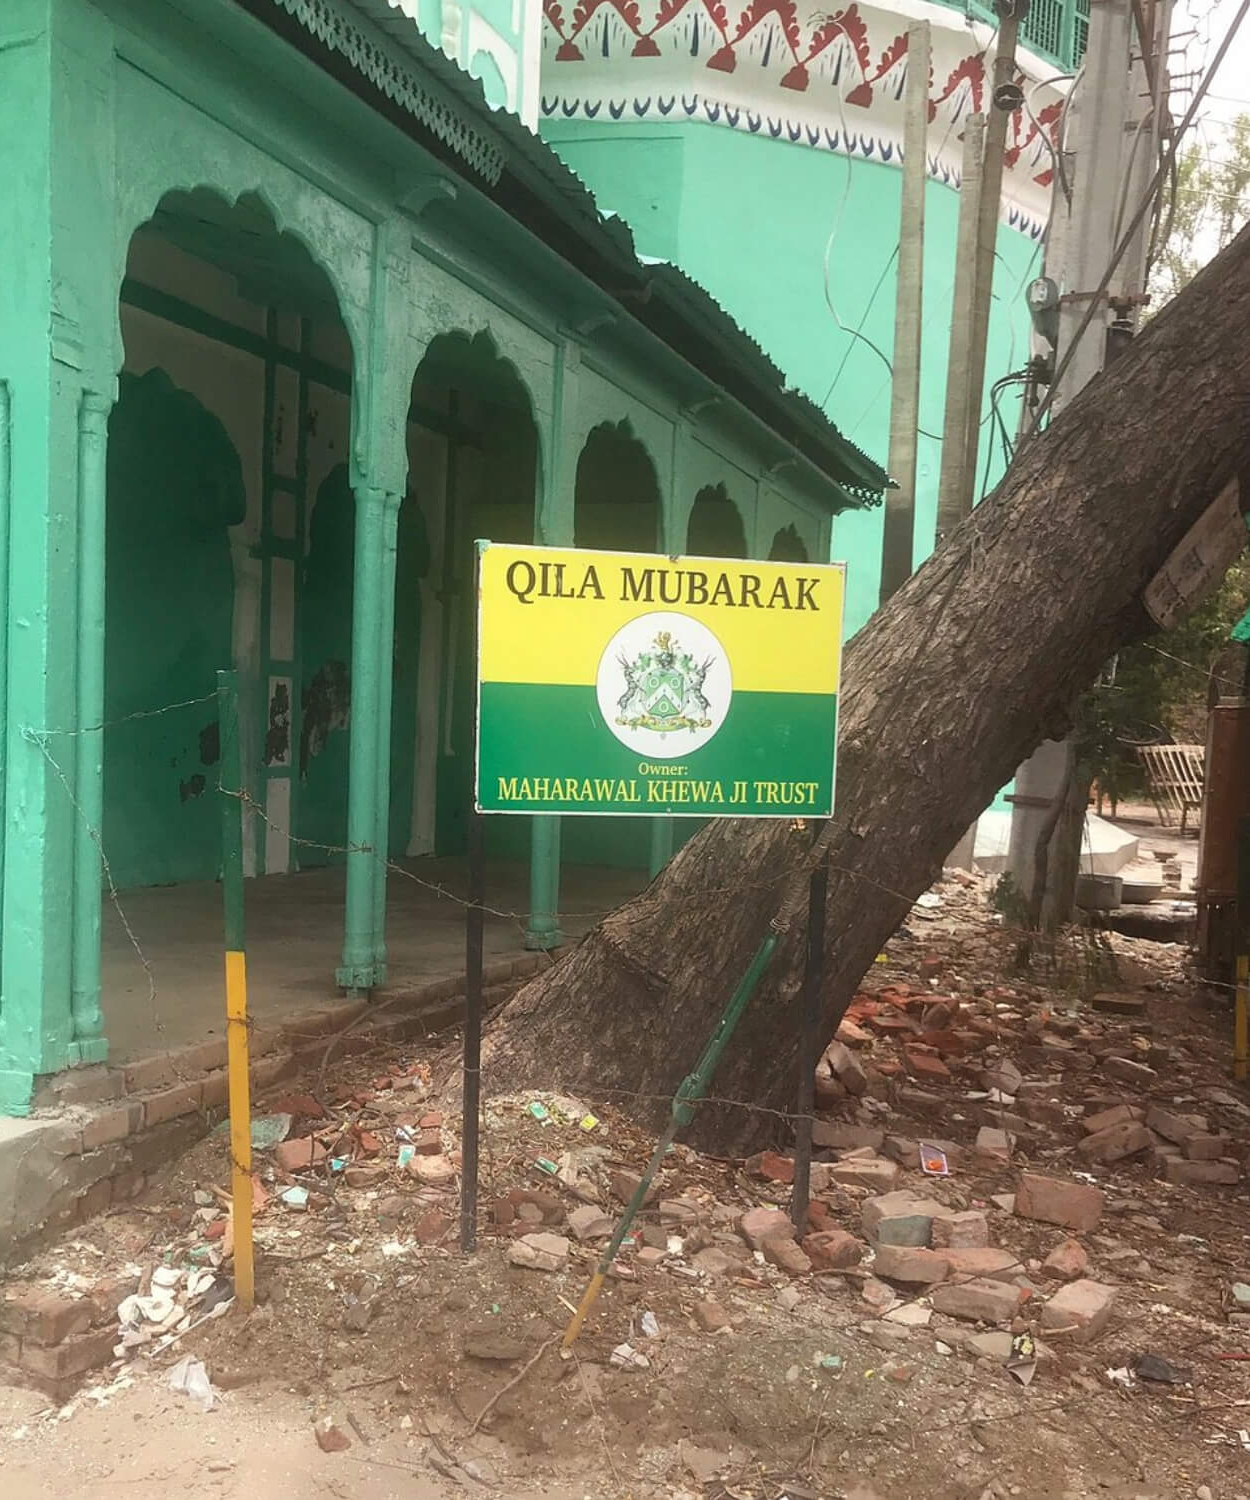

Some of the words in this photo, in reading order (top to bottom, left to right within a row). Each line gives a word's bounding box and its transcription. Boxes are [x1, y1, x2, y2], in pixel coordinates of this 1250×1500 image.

[506, 560, 605, 604] QILA
[620, 567, 821, 611] MUBARAK
[638, 761, 688, 775] Owner:
[498, 777, 641, 802] MAHARAWAL
[647, 780, 724, 803] KHEWA
[729, 781, 748, 804] JI
[754, 782, 818, 804] TRUST
